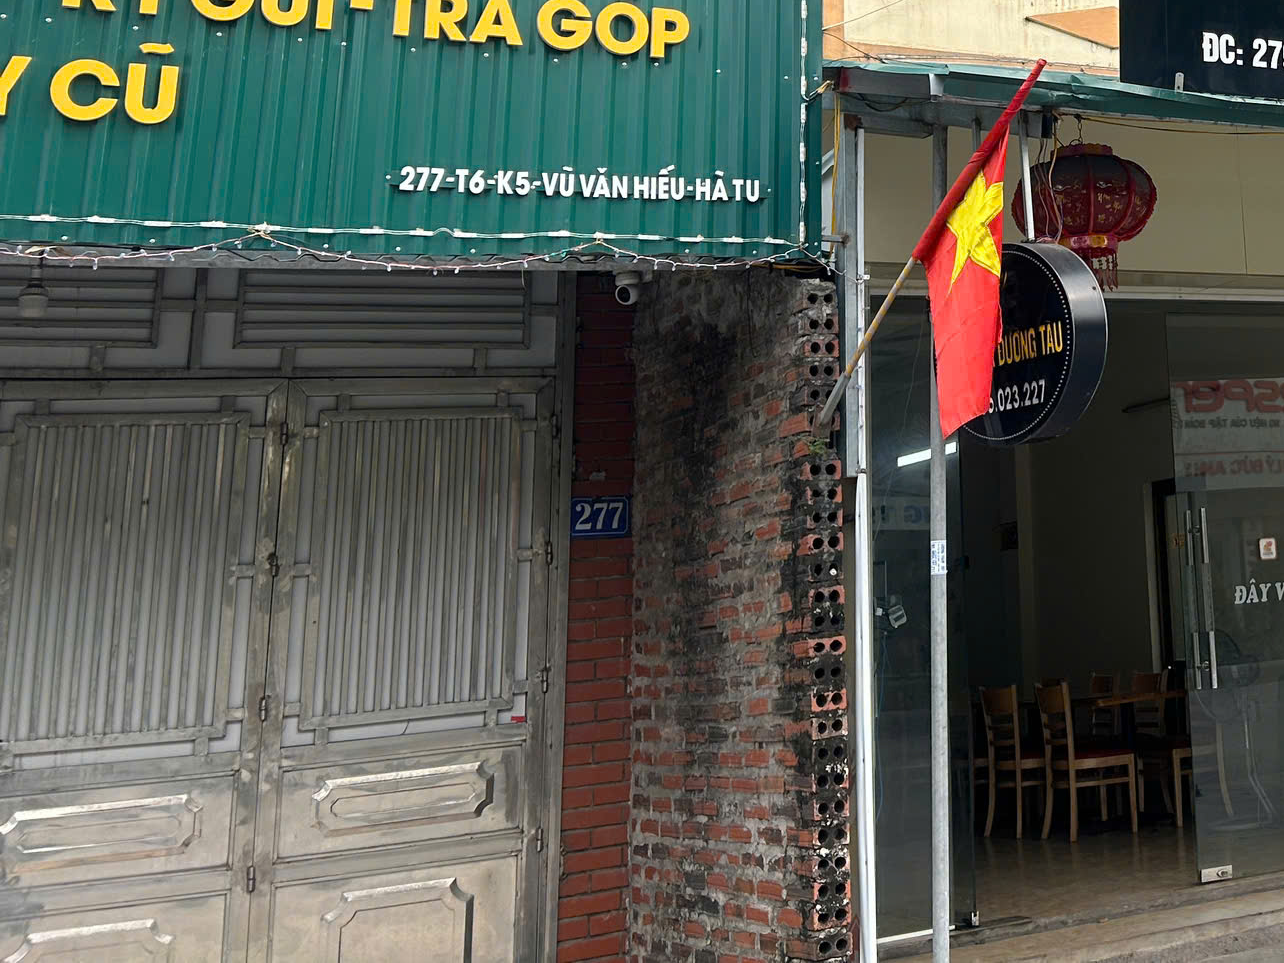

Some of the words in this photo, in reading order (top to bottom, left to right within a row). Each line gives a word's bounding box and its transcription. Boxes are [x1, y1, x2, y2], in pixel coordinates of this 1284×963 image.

[1202, 32, 1243, 66] ĐC:
[50, 42, 179, 124] CŨ
[580, 167, 630, 199] VĂN
[732, 179, 760, 202] TU
[575, 502, 624, 530] 277
